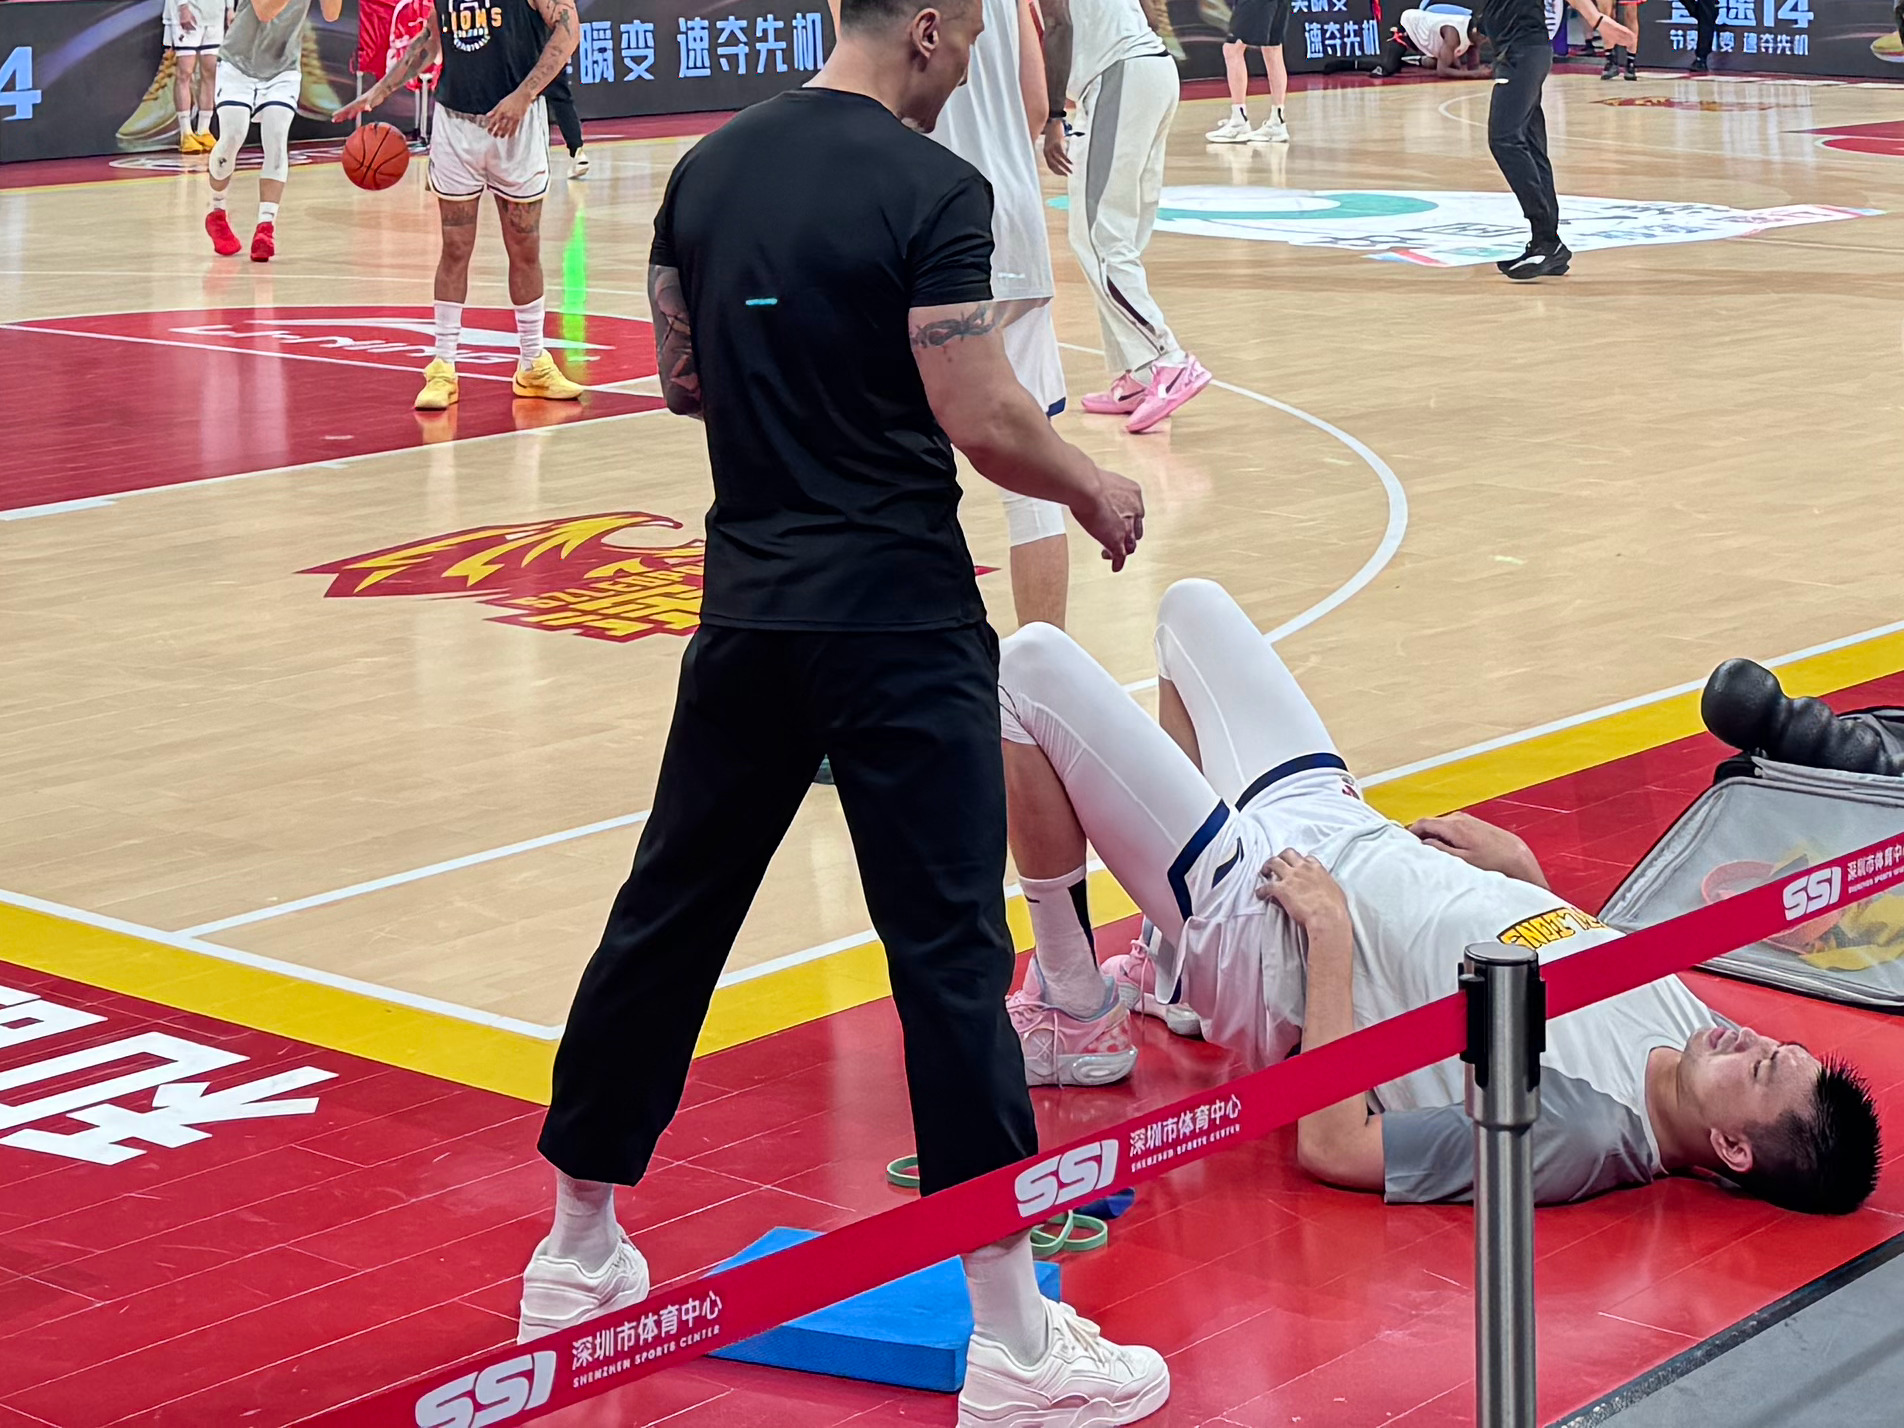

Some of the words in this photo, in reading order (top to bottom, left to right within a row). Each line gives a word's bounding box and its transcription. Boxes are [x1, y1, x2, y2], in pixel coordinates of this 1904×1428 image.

[566, 20, 655, 85] 瞬变
[676, 11, 826, 79] 速夺先机
[1306, 18, 1382, 60] 速夺先机
[1783, 865, 1842, 921] SSI
[1014, 1139, 1119, 1217] SSI
[1128, 1094, 1242, 1157] 深圳市体育中心
[415, 1350, 557, 1428] SSI
[571, 1291, 723, 1371] 深圳市体育中心
[573, 1357, 632, 1389] SHENZHEN
[634, 1340, 677, 1370] SPORTS
[679, 1323, 721, 1354] CENTER
